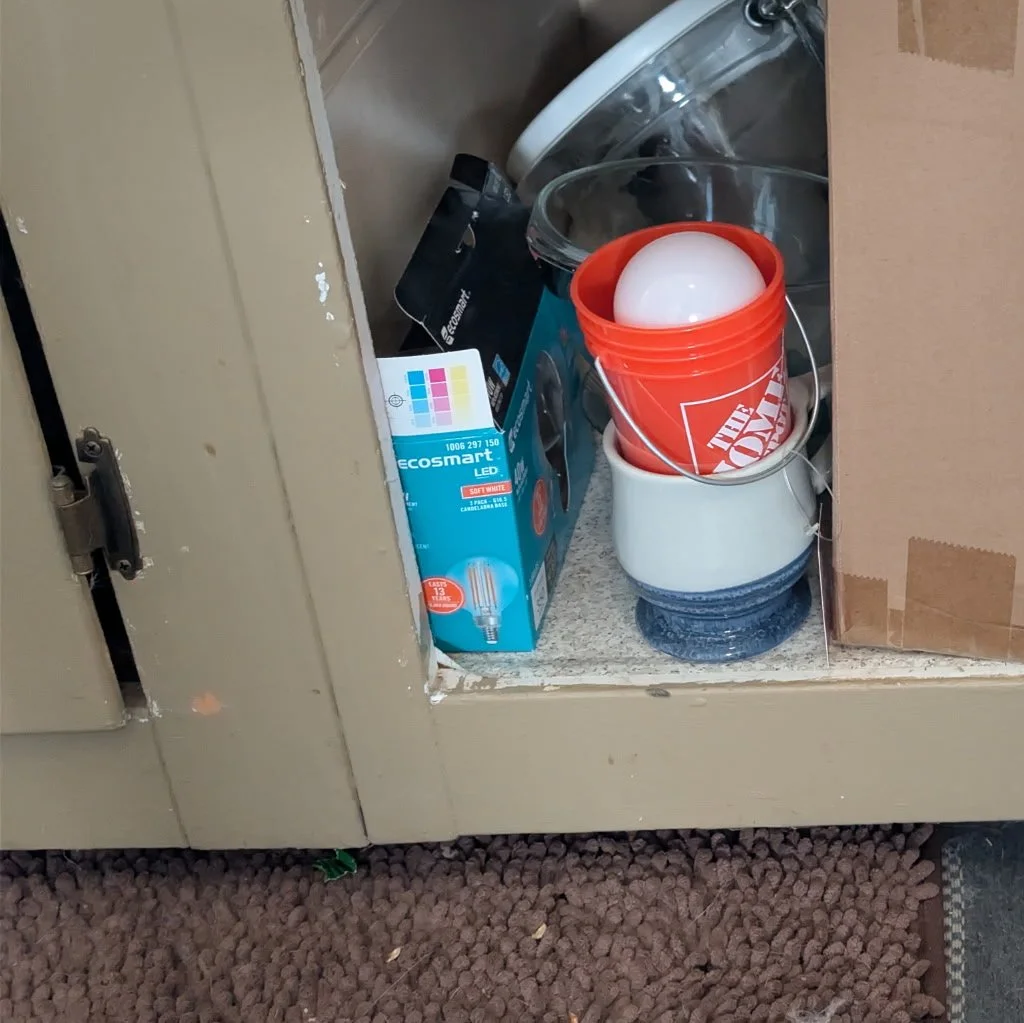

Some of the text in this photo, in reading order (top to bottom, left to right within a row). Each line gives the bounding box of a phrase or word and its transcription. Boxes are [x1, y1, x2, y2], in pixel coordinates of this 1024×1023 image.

[446, 287, 470, 337] ecosmart
[707, 403, 754, 452] THE
[445, 438, 500, 452] 1006 297 150
[397, 447, 494, 470] ecosmart
[474, 466, 499, 478] LED
[470, 484, 505, 495] SOFT WHITE
[433, 588, 446, 596] 13
